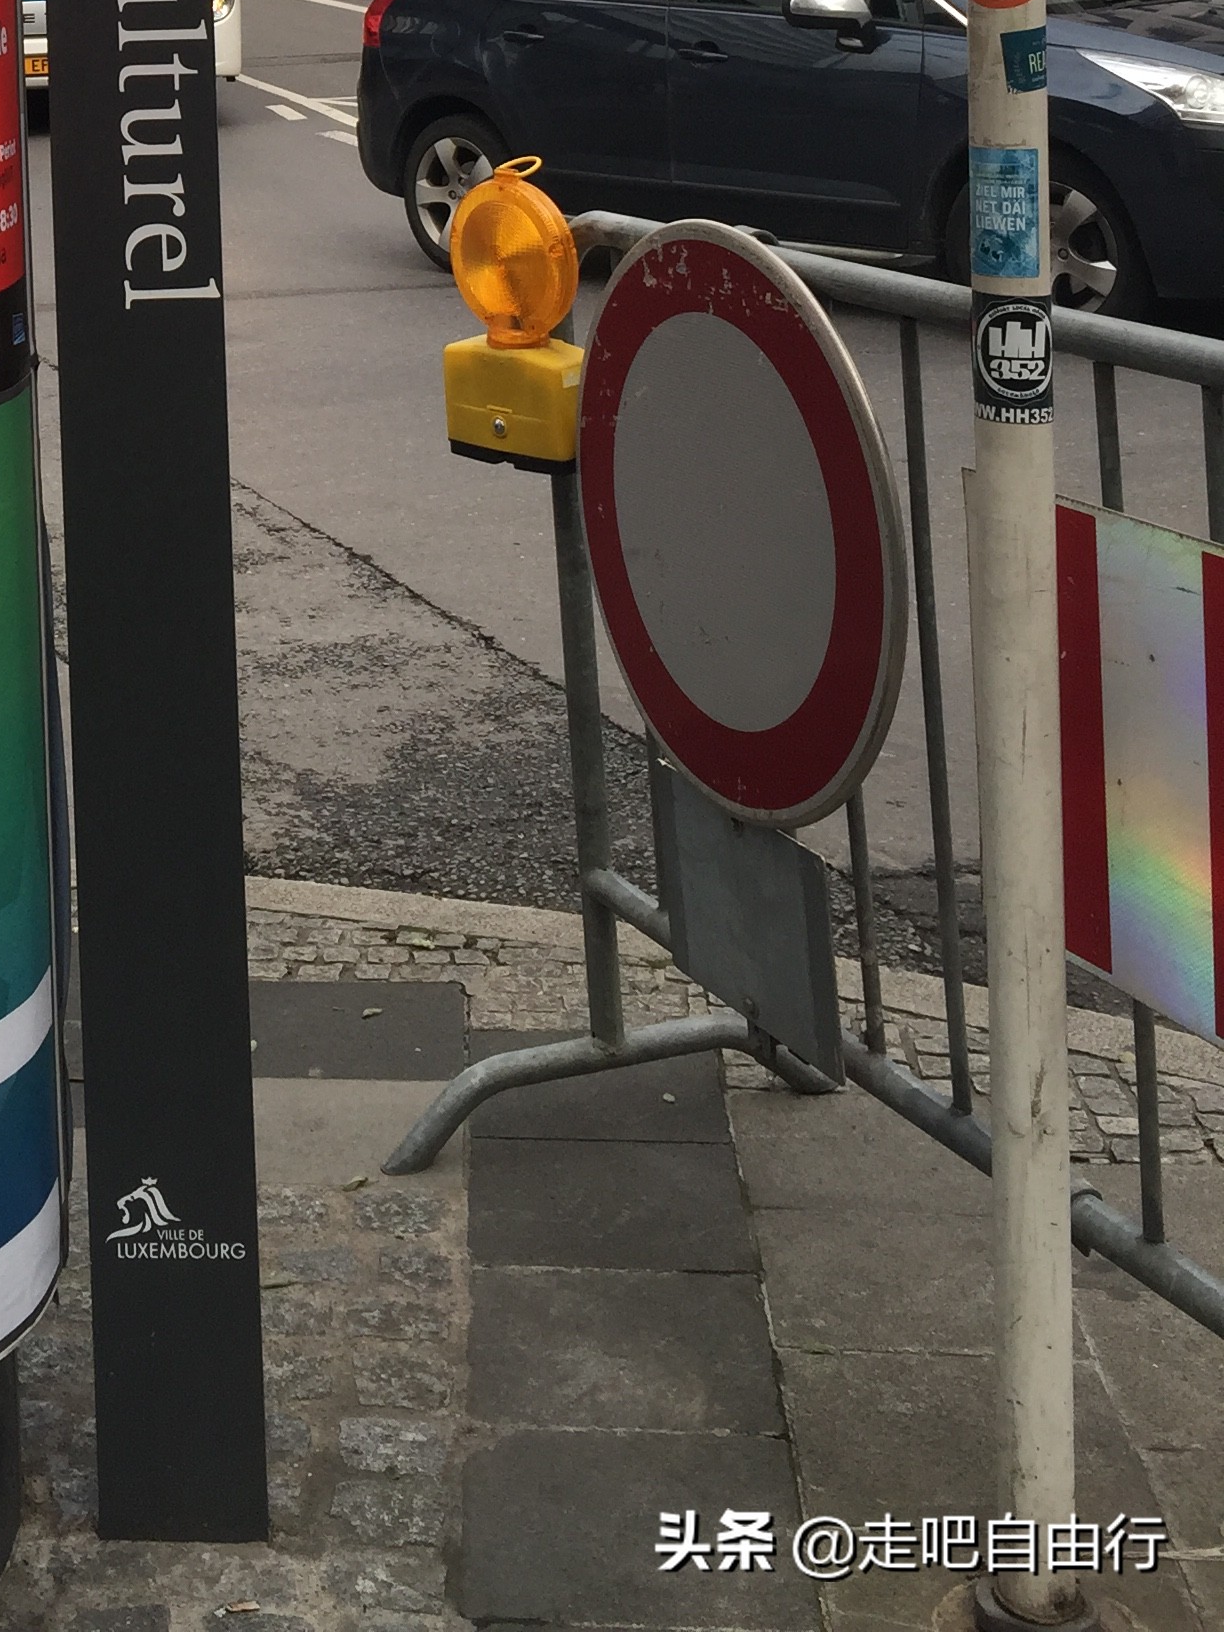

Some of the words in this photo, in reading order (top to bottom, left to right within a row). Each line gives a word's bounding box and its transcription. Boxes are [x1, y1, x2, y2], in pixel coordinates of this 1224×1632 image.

[1001, 186, 1025, 198] MIR
[976, 216, 1025, 231] LIEWEN
[990, 359, 1045, 380] 352
[157, 1229, 184, 1240] VILLE
[189, 1230, 204, 1240] DE
[117, 1243, 245, 1259] LUXEMBOURG
